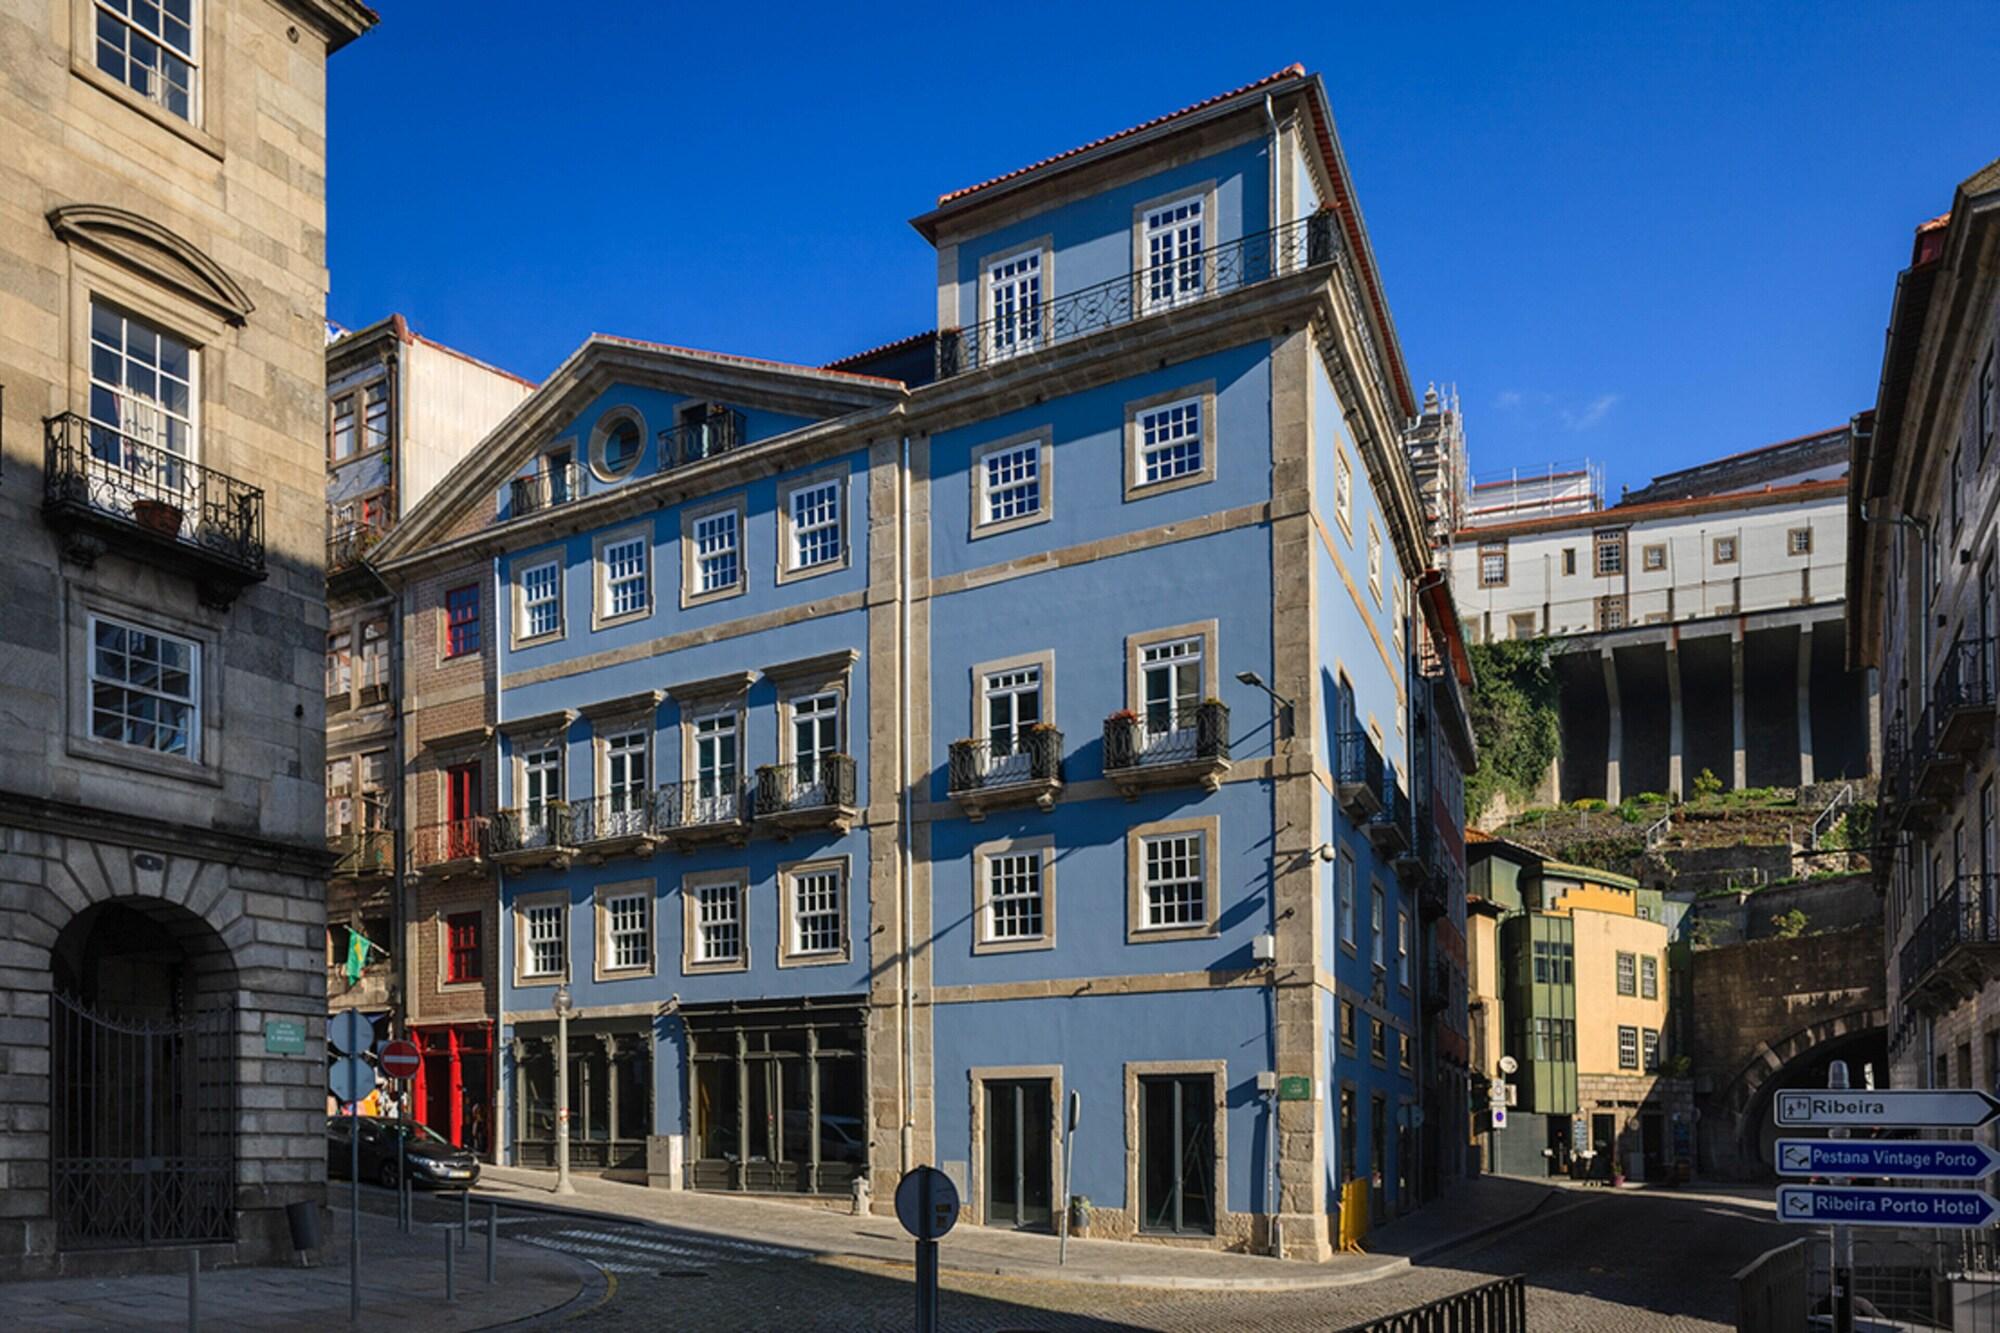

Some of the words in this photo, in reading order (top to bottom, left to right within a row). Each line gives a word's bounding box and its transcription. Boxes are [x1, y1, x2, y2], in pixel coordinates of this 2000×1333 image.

[1813, 1099, 1885, 1114] Ribeira
[1813, 1148, 1870, 1164] Pestana
[1872, 1149, 1931, 1170] Vintage
[1935, 1150, 1977, 1167] Porto
[1816, 1195, 1876, 1212] Ribeira
[1881, 1197, 1929, 1214] Porto
[1933, 1199, 1980, 1215] Hotel
